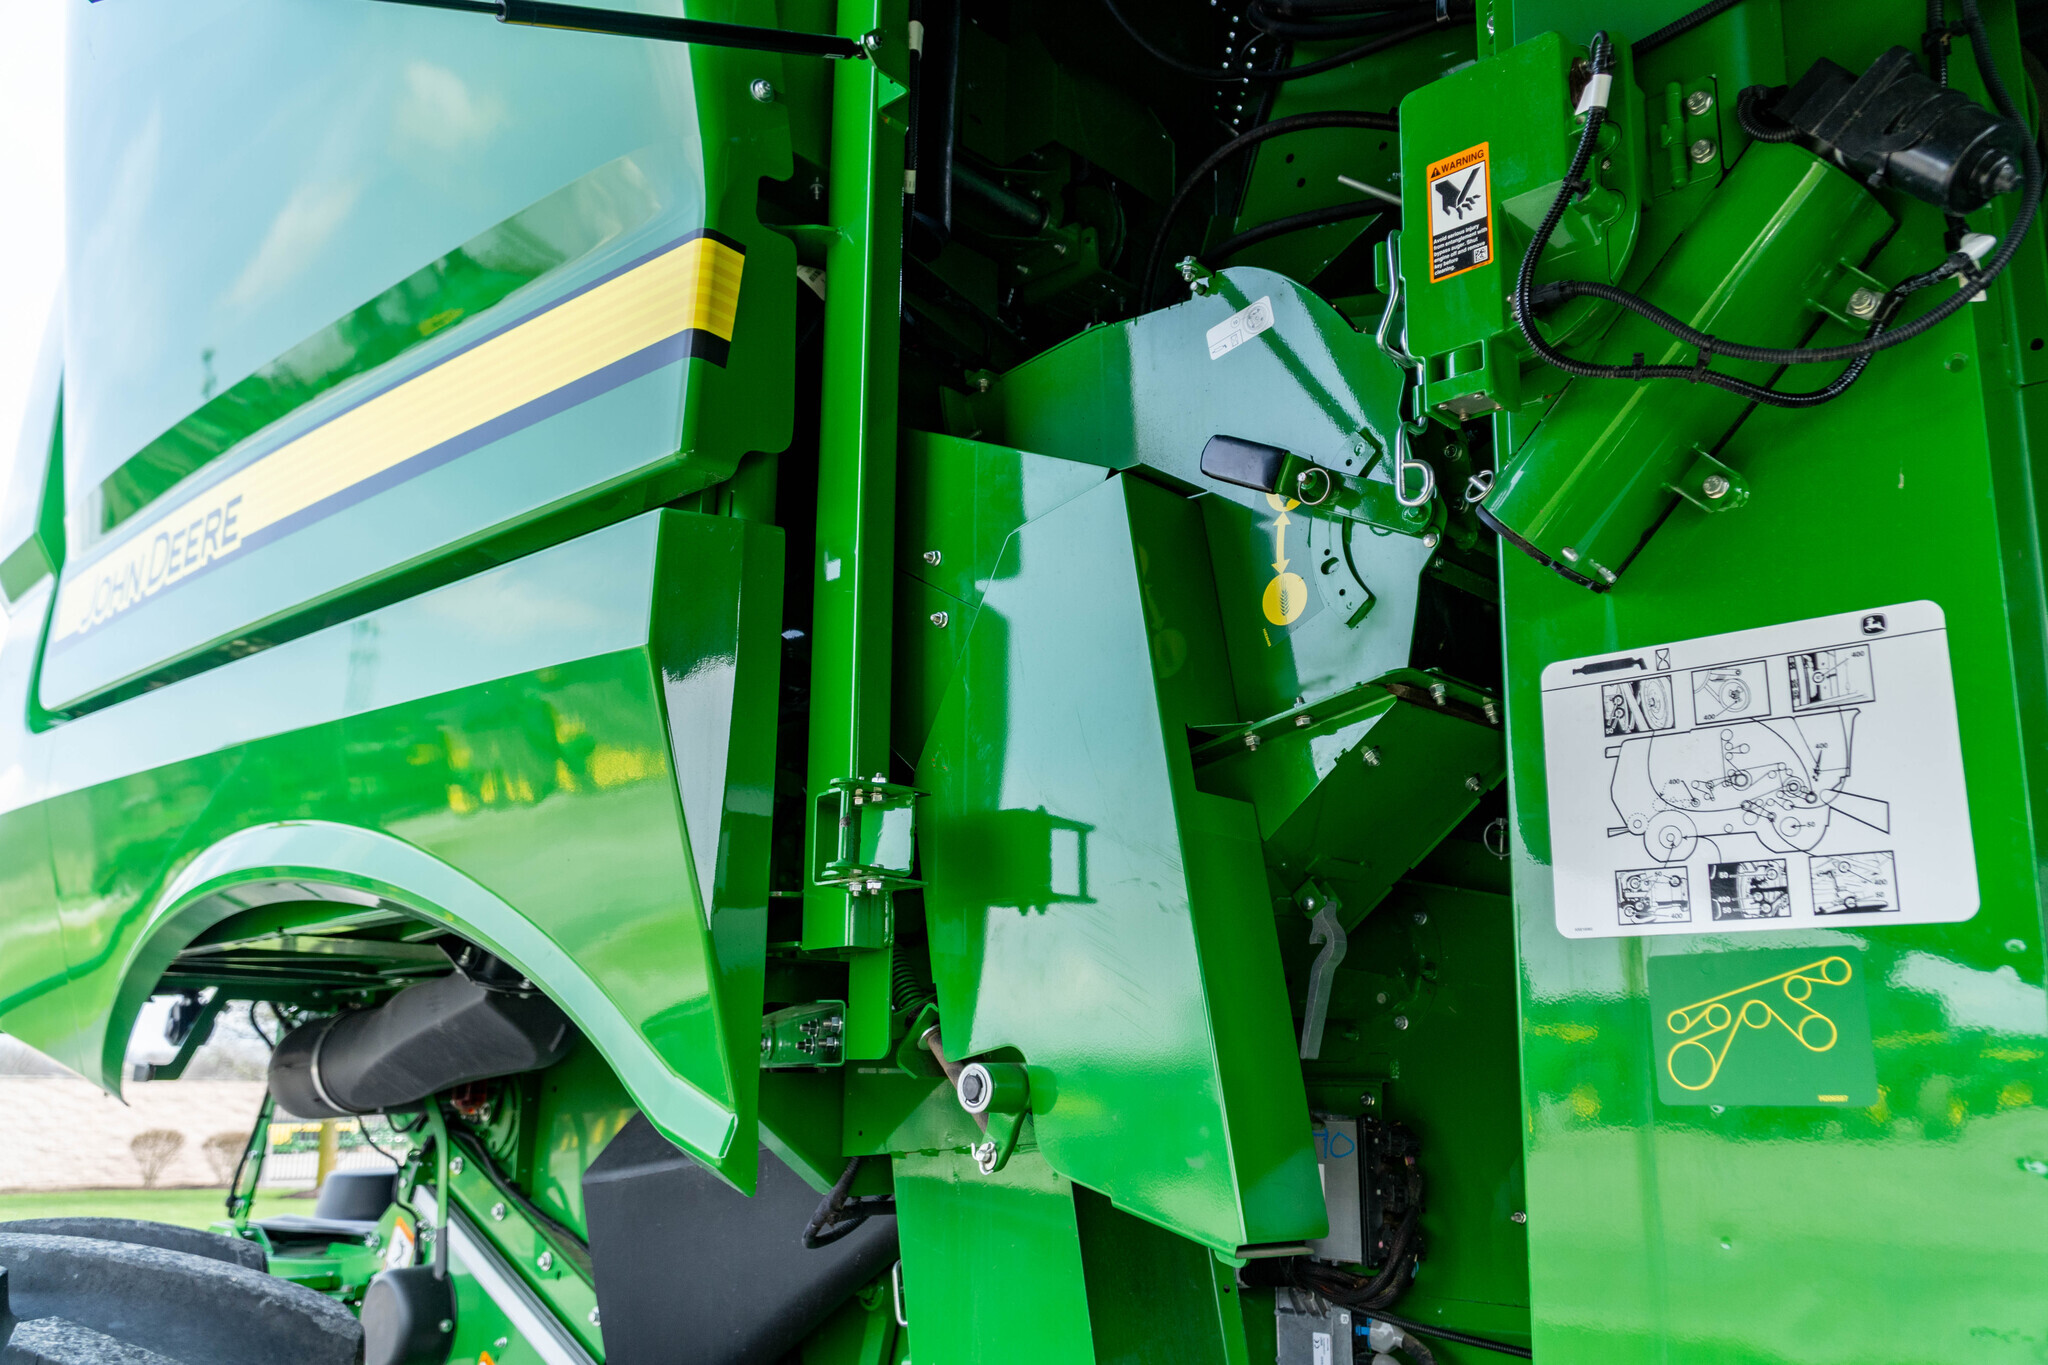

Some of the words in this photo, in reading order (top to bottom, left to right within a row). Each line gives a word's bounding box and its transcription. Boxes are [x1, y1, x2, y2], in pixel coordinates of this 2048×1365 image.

[1441, 150, 1484, 173] WARNING
[1434, 235, 1447, 244] Avoid
[1448, 229, 1465, 239] serious
[1466, 223, 1480, 233] injury
[1445, 231, 1477, 246] entanglement
[1434, 248, 1450, 257] bypass
[1451, 242, 1466, 250] auger.
[1466, 237, 1478, 245] Shut
[1434, 254, 1450, 263] engine
[1458, 247, 1467, 255] and
[1467, 241, 1485, 251] remove
[1434, 265, 1456, 276] cleaning.
[1443, 257, 1459, 266] before
[78, 552, 145, 626] JOHN
[148, 494, 243, 588] DEERE
